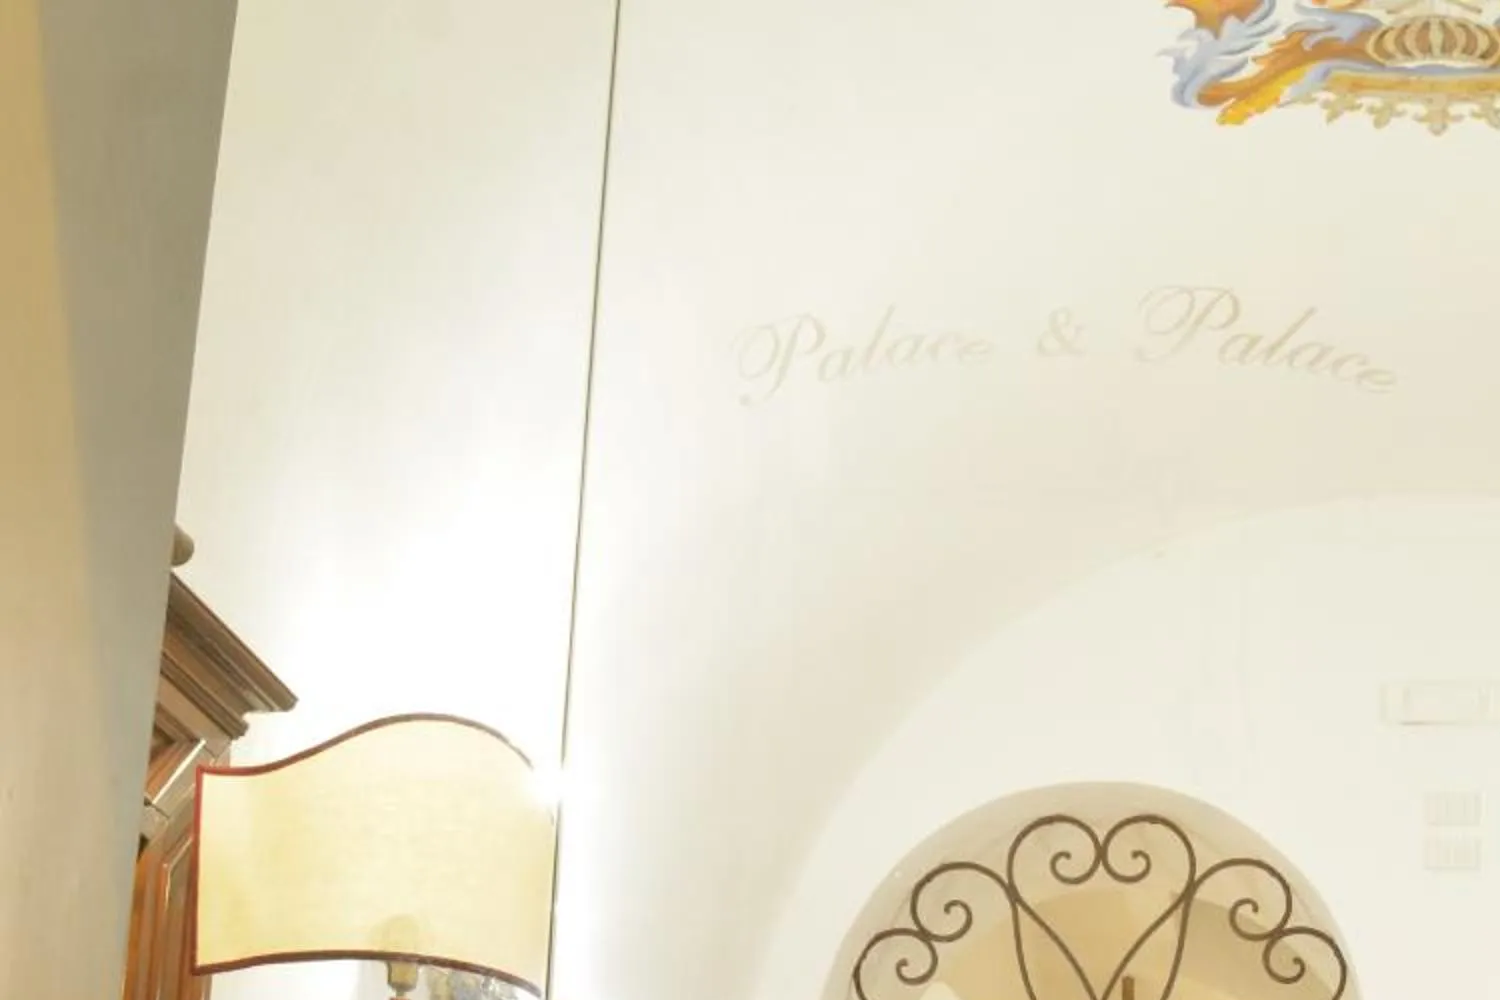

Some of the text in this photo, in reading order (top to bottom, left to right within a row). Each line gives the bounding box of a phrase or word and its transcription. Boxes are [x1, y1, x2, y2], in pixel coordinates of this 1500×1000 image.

[730, 283, 1399, 406] Palace & Palace
